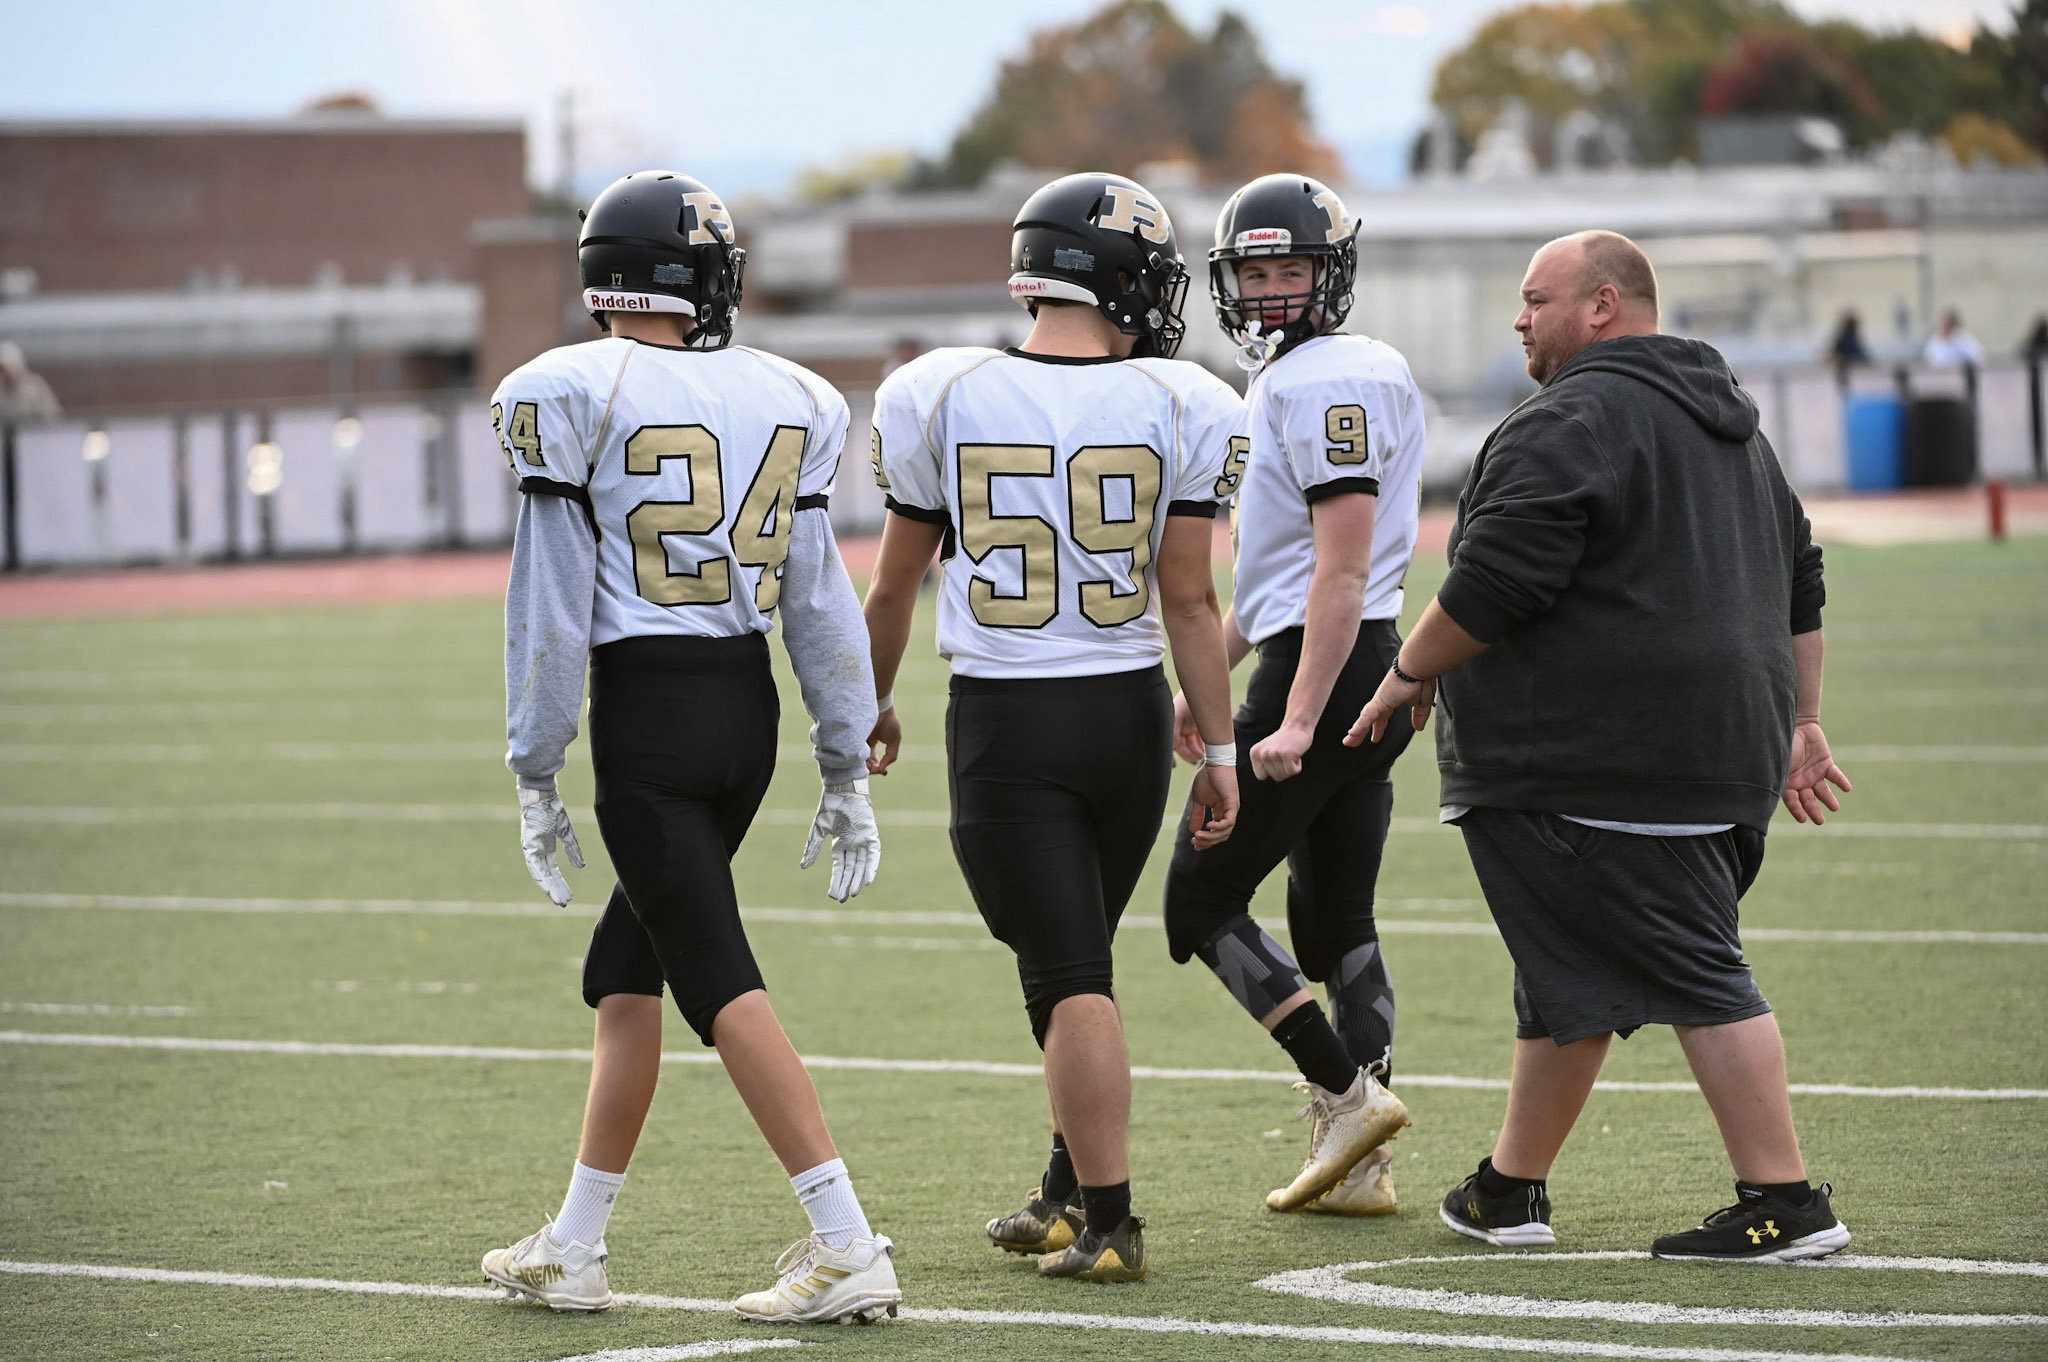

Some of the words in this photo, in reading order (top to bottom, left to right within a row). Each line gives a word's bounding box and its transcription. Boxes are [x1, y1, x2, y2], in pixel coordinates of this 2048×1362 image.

[1248, 231, 1278, 241] Riddell
[611, 273, 623, 285] 17
[591, 295, 650, 309] Riddell
[1325, 404, 1369, 465] 9
[625, 424, 808, 612] 24
[957, 443, 1162, 629] 59
